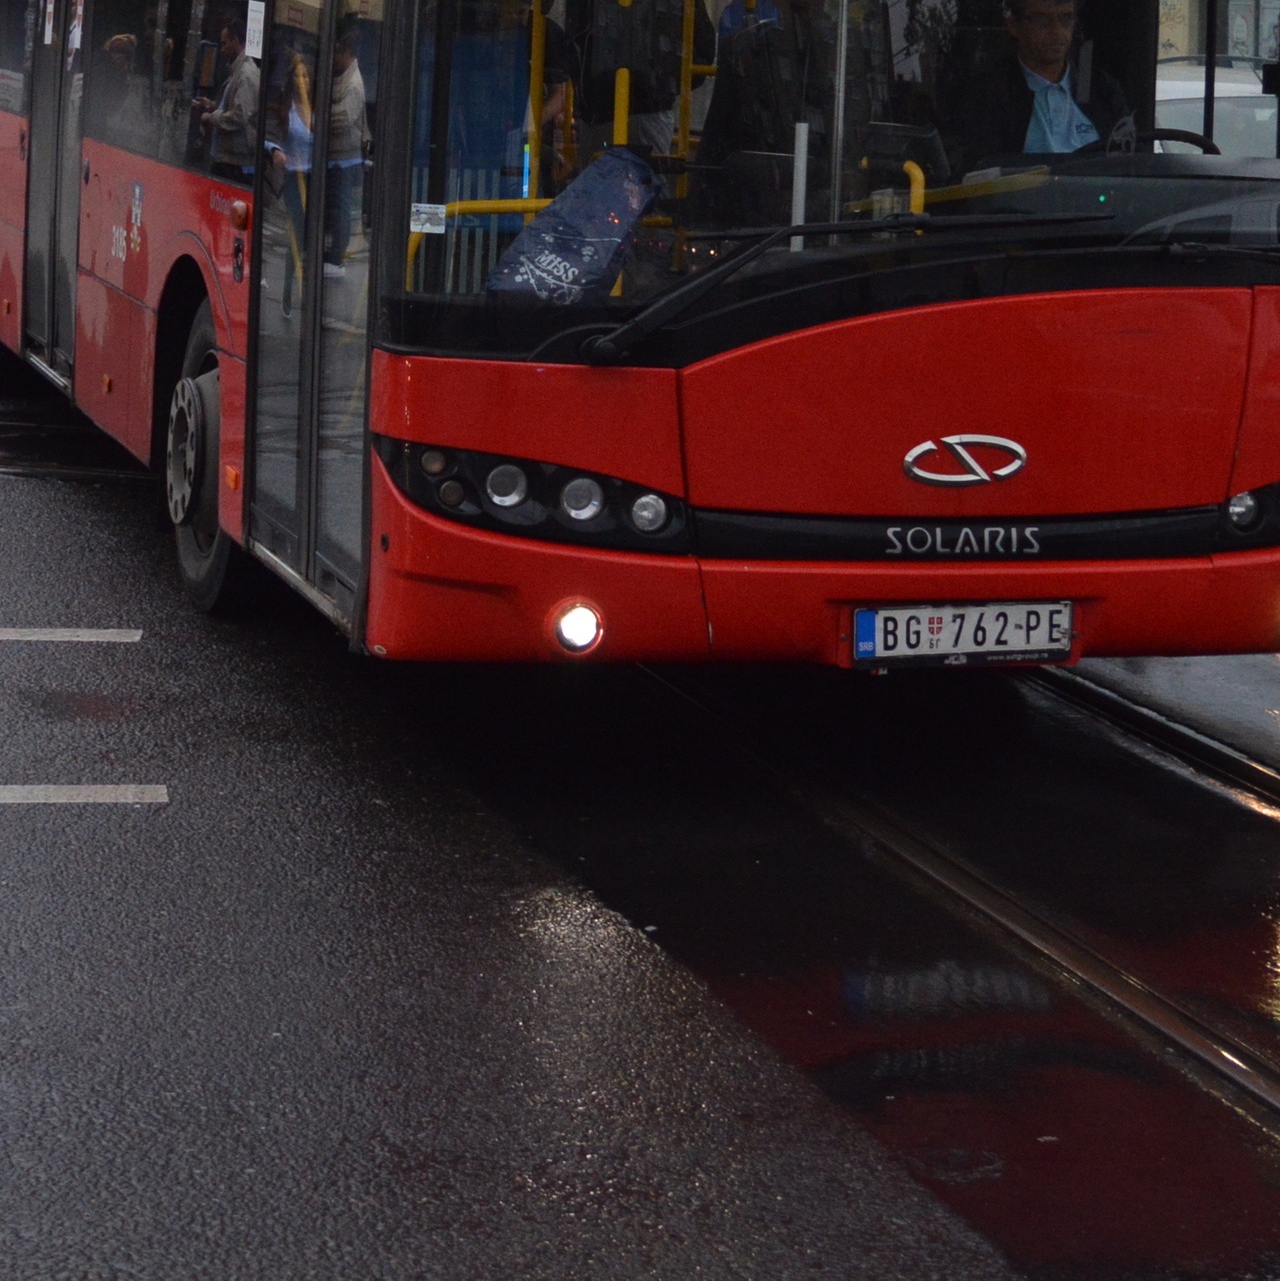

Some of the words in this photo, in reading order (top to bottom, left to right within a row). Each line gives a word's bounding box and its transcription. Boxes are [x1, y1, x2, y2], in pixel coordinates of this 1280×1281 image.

[535, 249, 579, 283] MISS
[885, 526, 1040, 554] SOLARIS
[859, 641, 874, 651] SRB
[882, 615, 921, 651] BG
